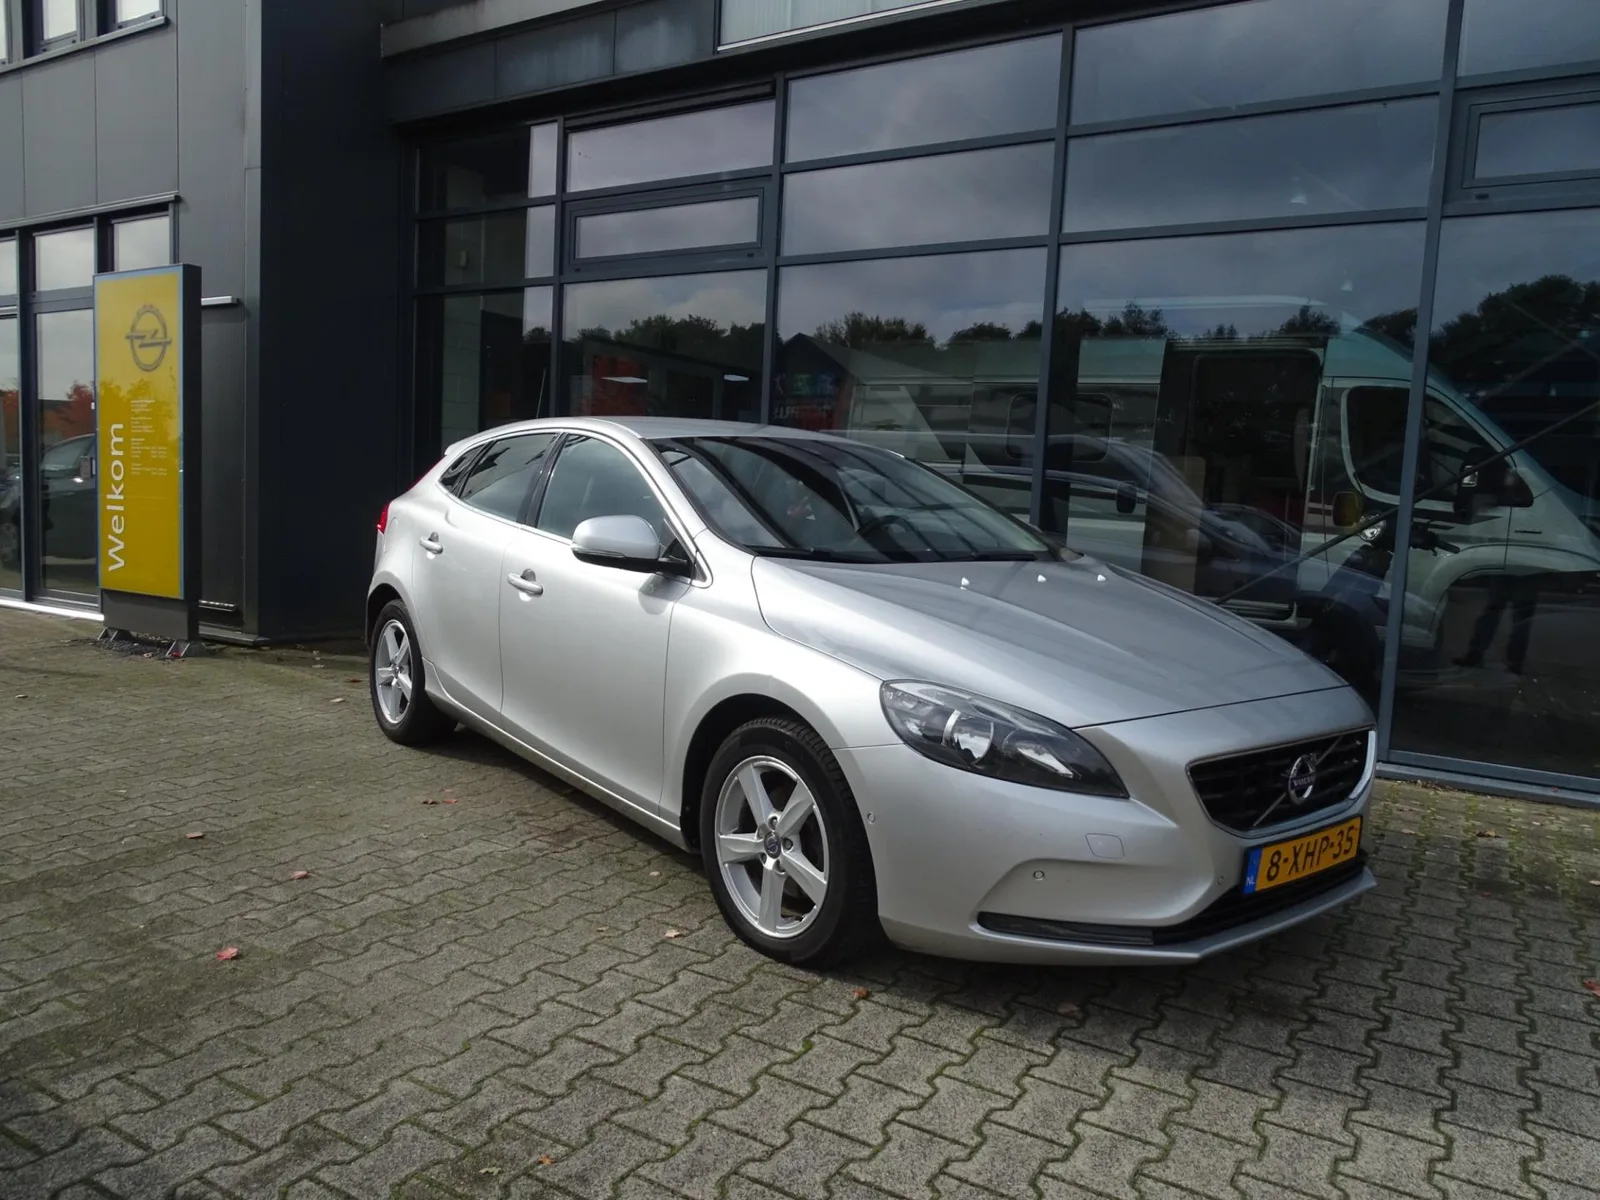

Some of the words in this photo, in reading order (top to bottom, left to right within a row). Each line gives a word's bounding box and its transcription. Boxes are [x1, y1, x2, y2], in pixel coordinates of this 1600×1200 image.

[106, 423, 125, 572] Welkom
[1245, 876, 1256, 886] NL
[1266, 825, 1354, 882] 8-XHP-35
